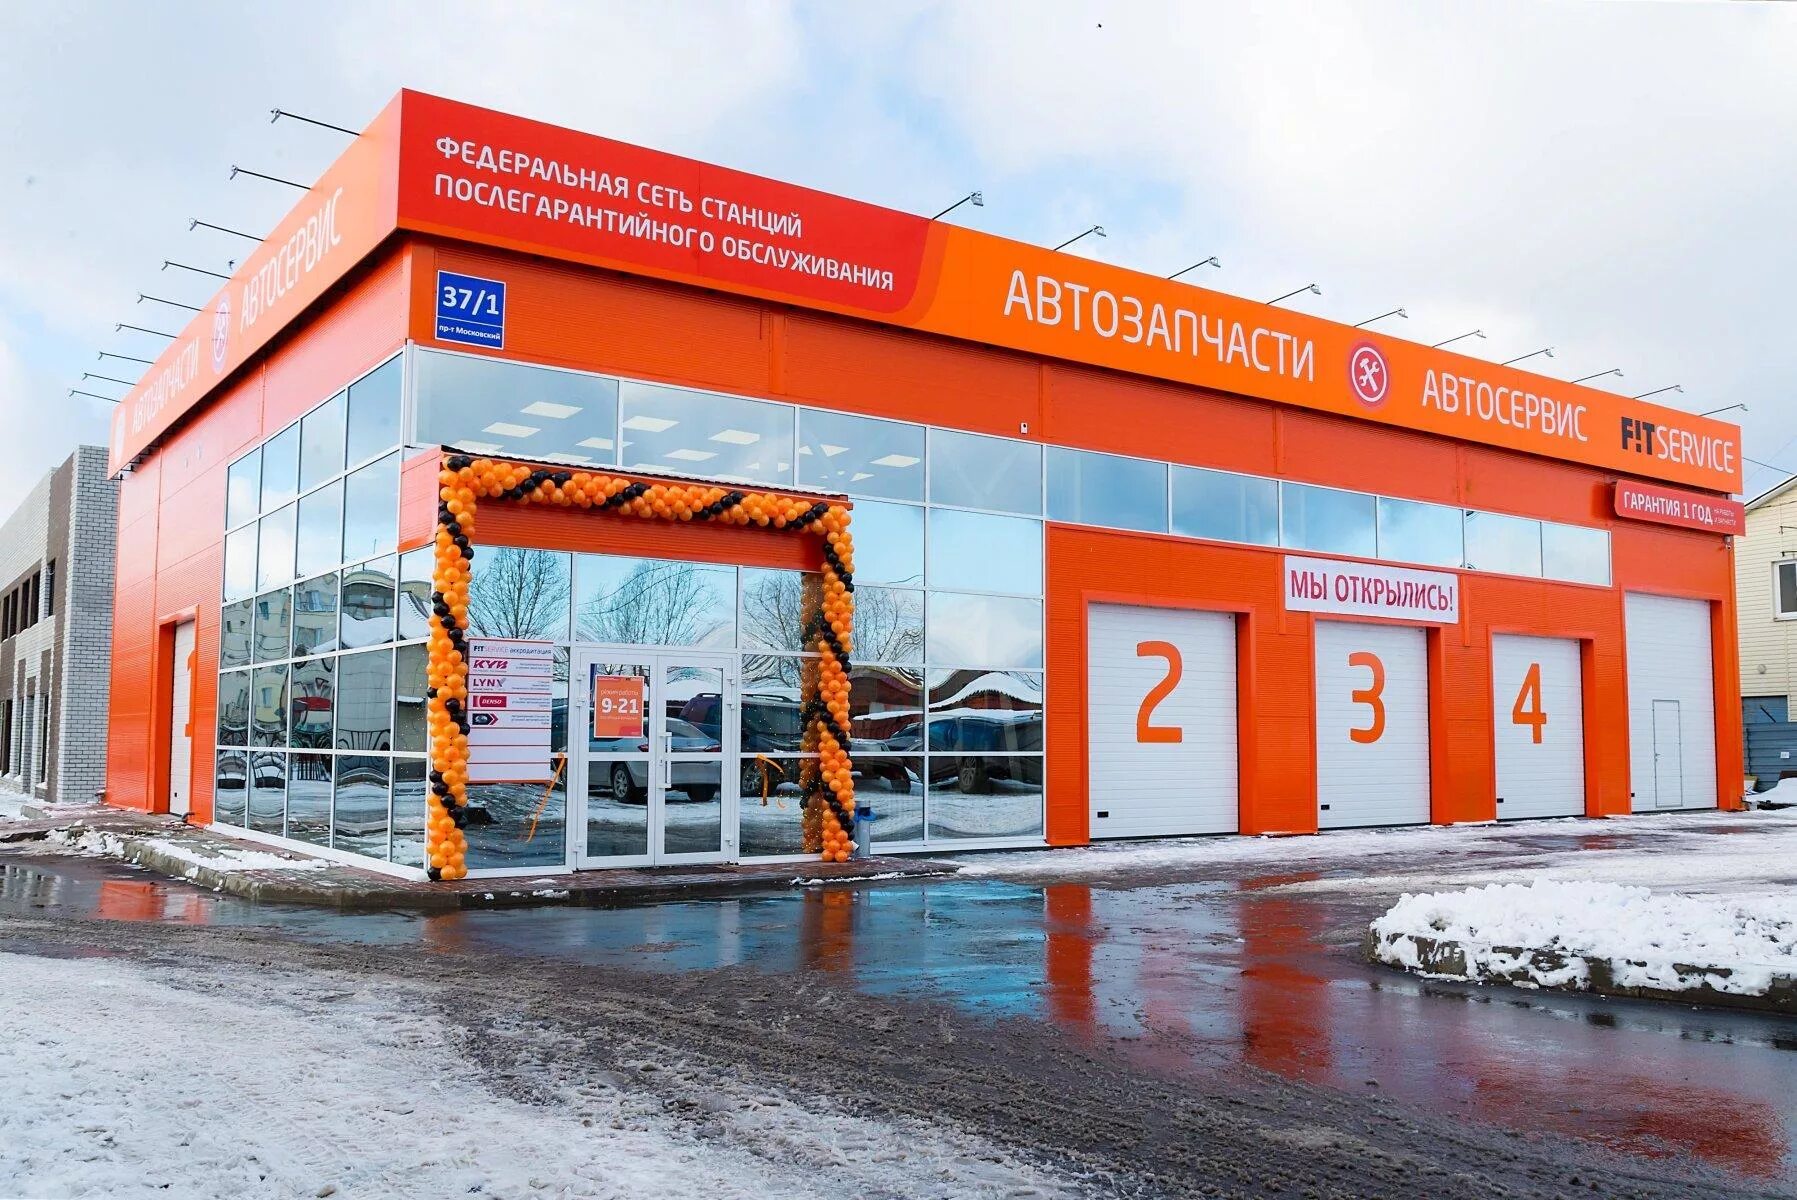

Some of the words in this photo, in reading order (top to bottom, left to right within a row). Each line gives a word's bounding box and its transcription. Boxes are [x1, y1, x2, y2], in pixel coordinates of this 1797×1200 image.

[436, 136, 629, 199] ФЕДЕРАЛЬНАЯ
[637, 182, 693, 213] СЕТЬ
[701, 197, 802, 239] СТАНЦИЙ
[240, 187, 343, 333] АВТОСЕРВИС
[434, 173, 715, 253] ПОСЛЕГАРАНТИЙНОГО
[722, 238, 894, 291] ОБСЛУЖИВАНИЯ
[439, 325, 455, 333] пр-т
[455, 327, 501, 340] Московский
[442, 286, 499, 316] 37/1
[1003, 269, 1315, 383] АВТОЗАПЧАСТИ
[132, 336, 200, 436] АВТОЗАПЧАСТИ
[1422, 368, 1589, 443] АВТОСЕРВИС
[1623, 491, 1681, 517] ГАРАНТИЯ
[1683, 502, 1690, 519] 1
[1691, 503, 1713, 526] ГОД
[1291, 570, 1327, 600] МЫ
[1335, 574, 1453, 612] ОТКРЫЛИСЬ!
[473, 660, 508, 669] KYB
[1136, 641, 1183, 744] 2
[1348, 652, 1386, 744] 3
[1512, 663, 1548, 744] 4
[601, 698, 639, 714] 9-21
